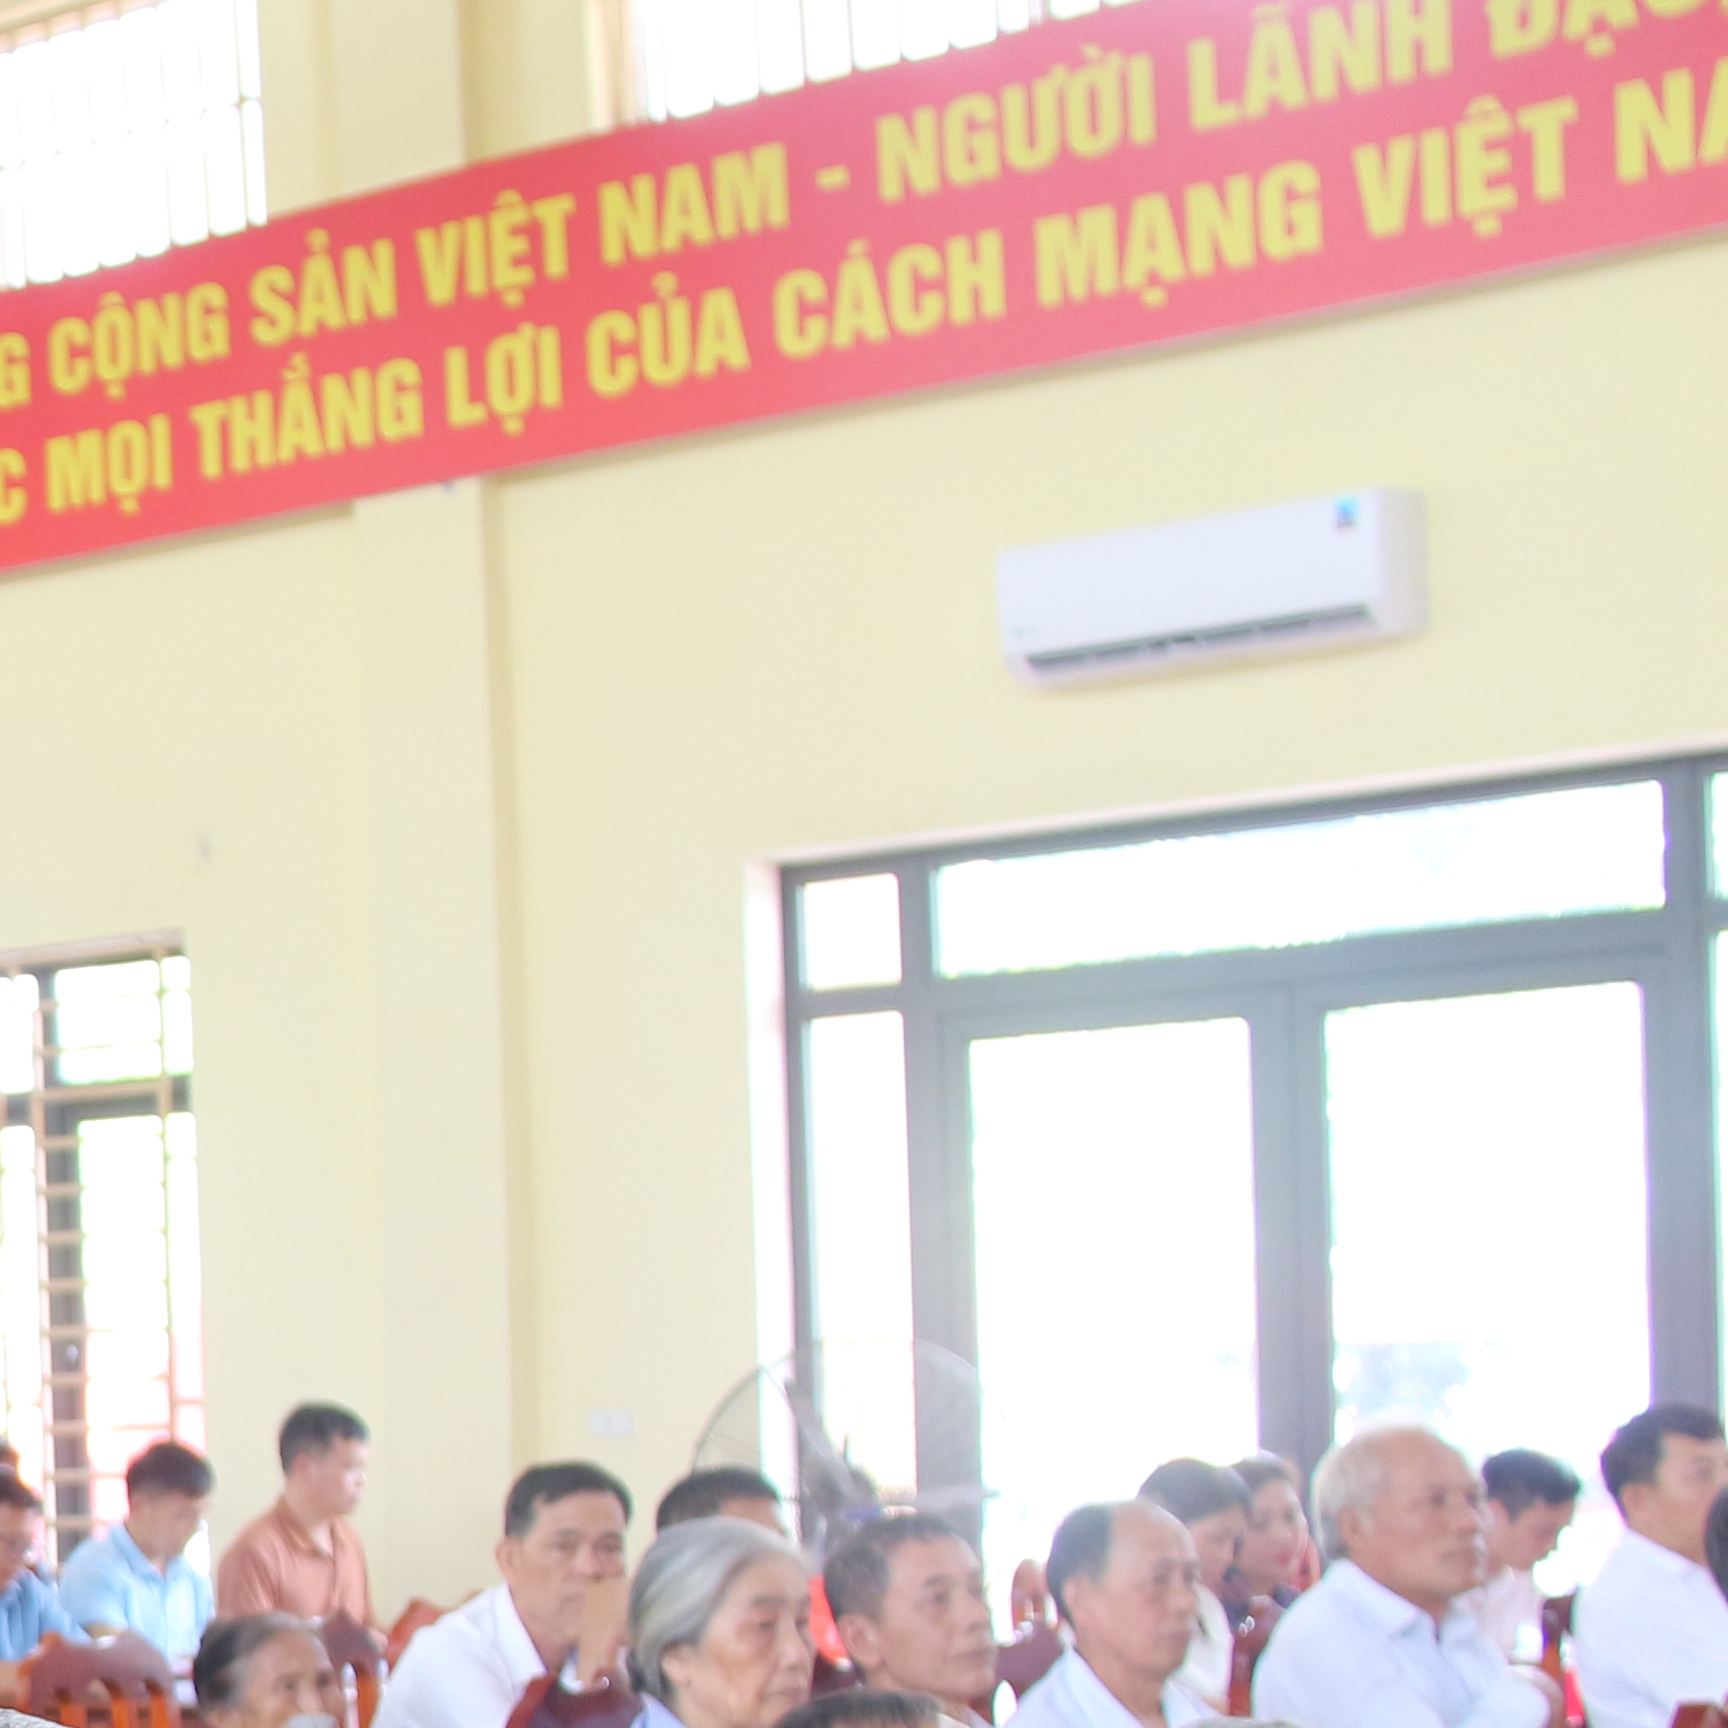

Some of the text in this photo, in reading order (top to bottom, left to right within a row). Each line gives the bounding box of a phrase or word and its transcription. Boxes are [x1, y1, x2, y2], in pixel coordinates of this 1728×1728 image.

[43, 412, 175, 515] MỌI
[187, 352, 426, 480] THẮNG
[443, 320, 564, 437] LỢI
[584, 270, 751, 398] CỦA
[772, 228, 1007, 360] CÁCH
[1033, 159, 1324, 308] MẠNG
[1352, 94, 1580, 239] VIỆT
[46, 281, 232, 401] CỘNG
[249, 227, 399, 349] SẢN
[413, 188, 578, 308] VIỆT
[597, 143, 790, 267] NAM
[875, 42, 1157, 202] NGƯỜI
[1186, 2, 1452, 131] LÃNH
